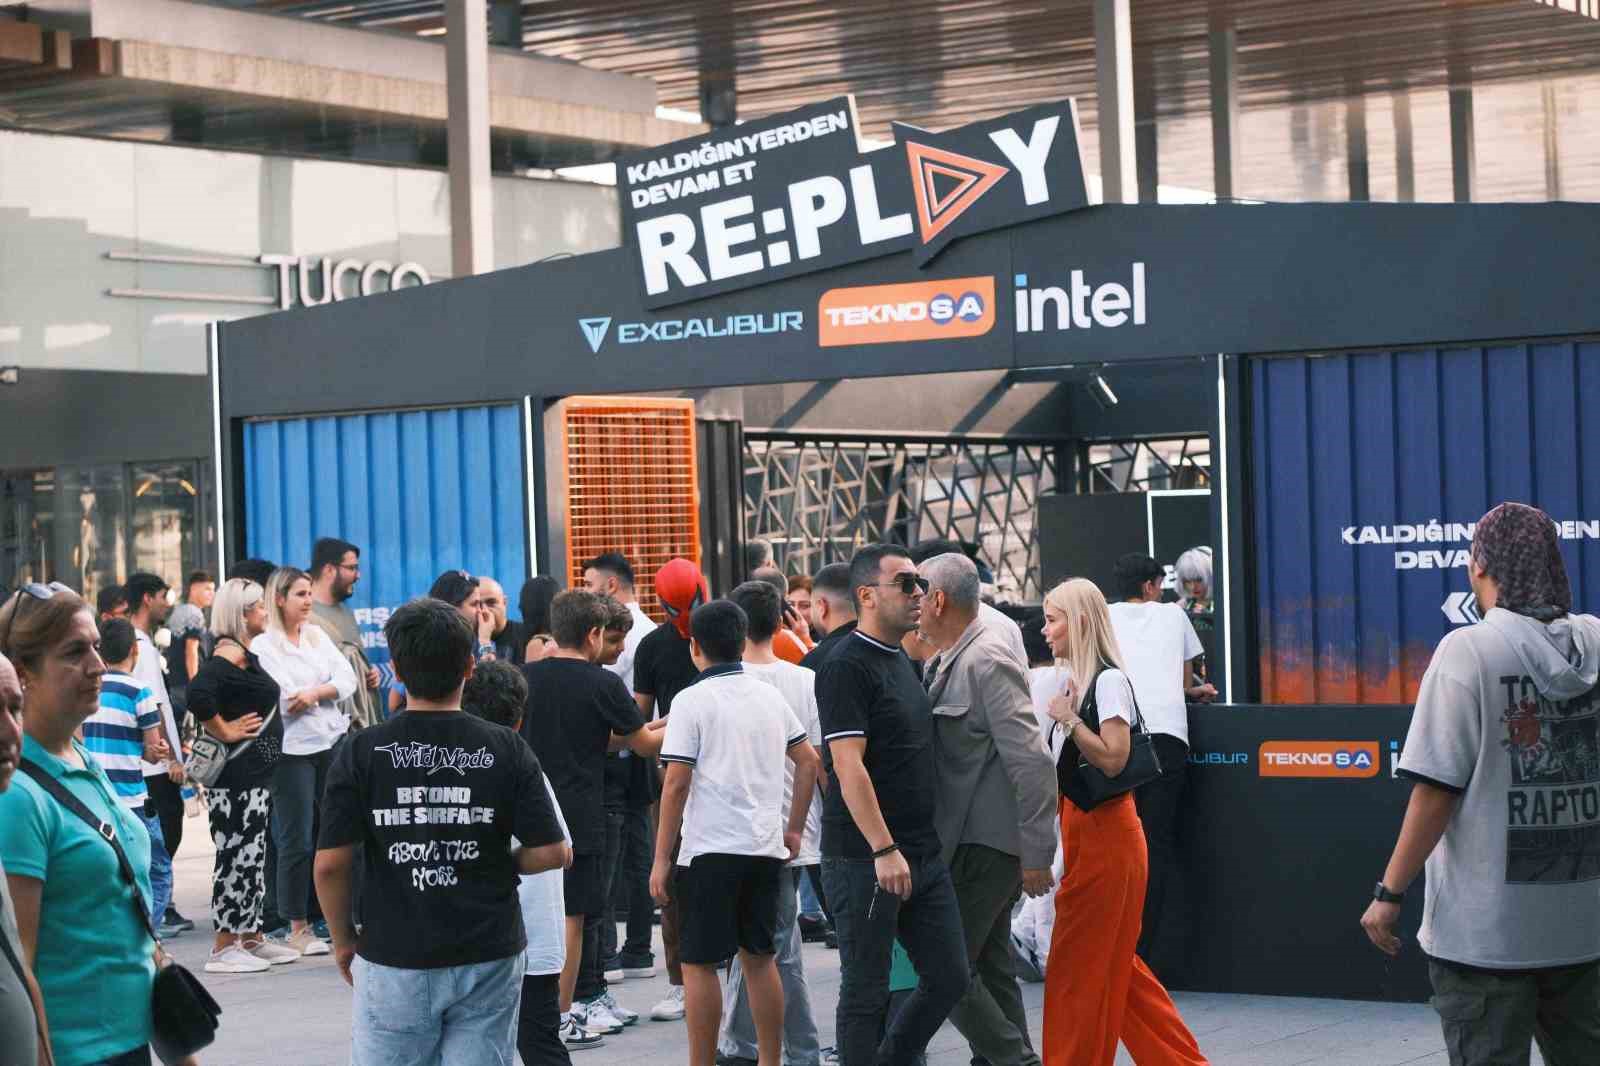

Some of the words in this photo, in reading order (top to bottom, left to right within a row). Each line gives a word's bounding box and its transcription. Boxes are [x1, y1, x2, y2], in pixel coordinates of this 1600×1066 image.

[631, 170, 720, 208] DEVAM
[723, 160, 757, 186] ET
[825, 294, 983, 327] TEKNOSA
[1016, 263, 1146, 332] intel
[617, 311, 803, 344] EXCALIBUR
[1342, 519, 1476, 544] KALDIĞIN
[1394, 550, 1471, 569] DEVA
[374, 741, 437, 768] Wild
[426, 747, 495, 775] Mode
[1264, 752, 1371, 766] TEKNOSA
[372, 808, 411, 826] THE
[1506, 786, 1600, 826] RAPTO
